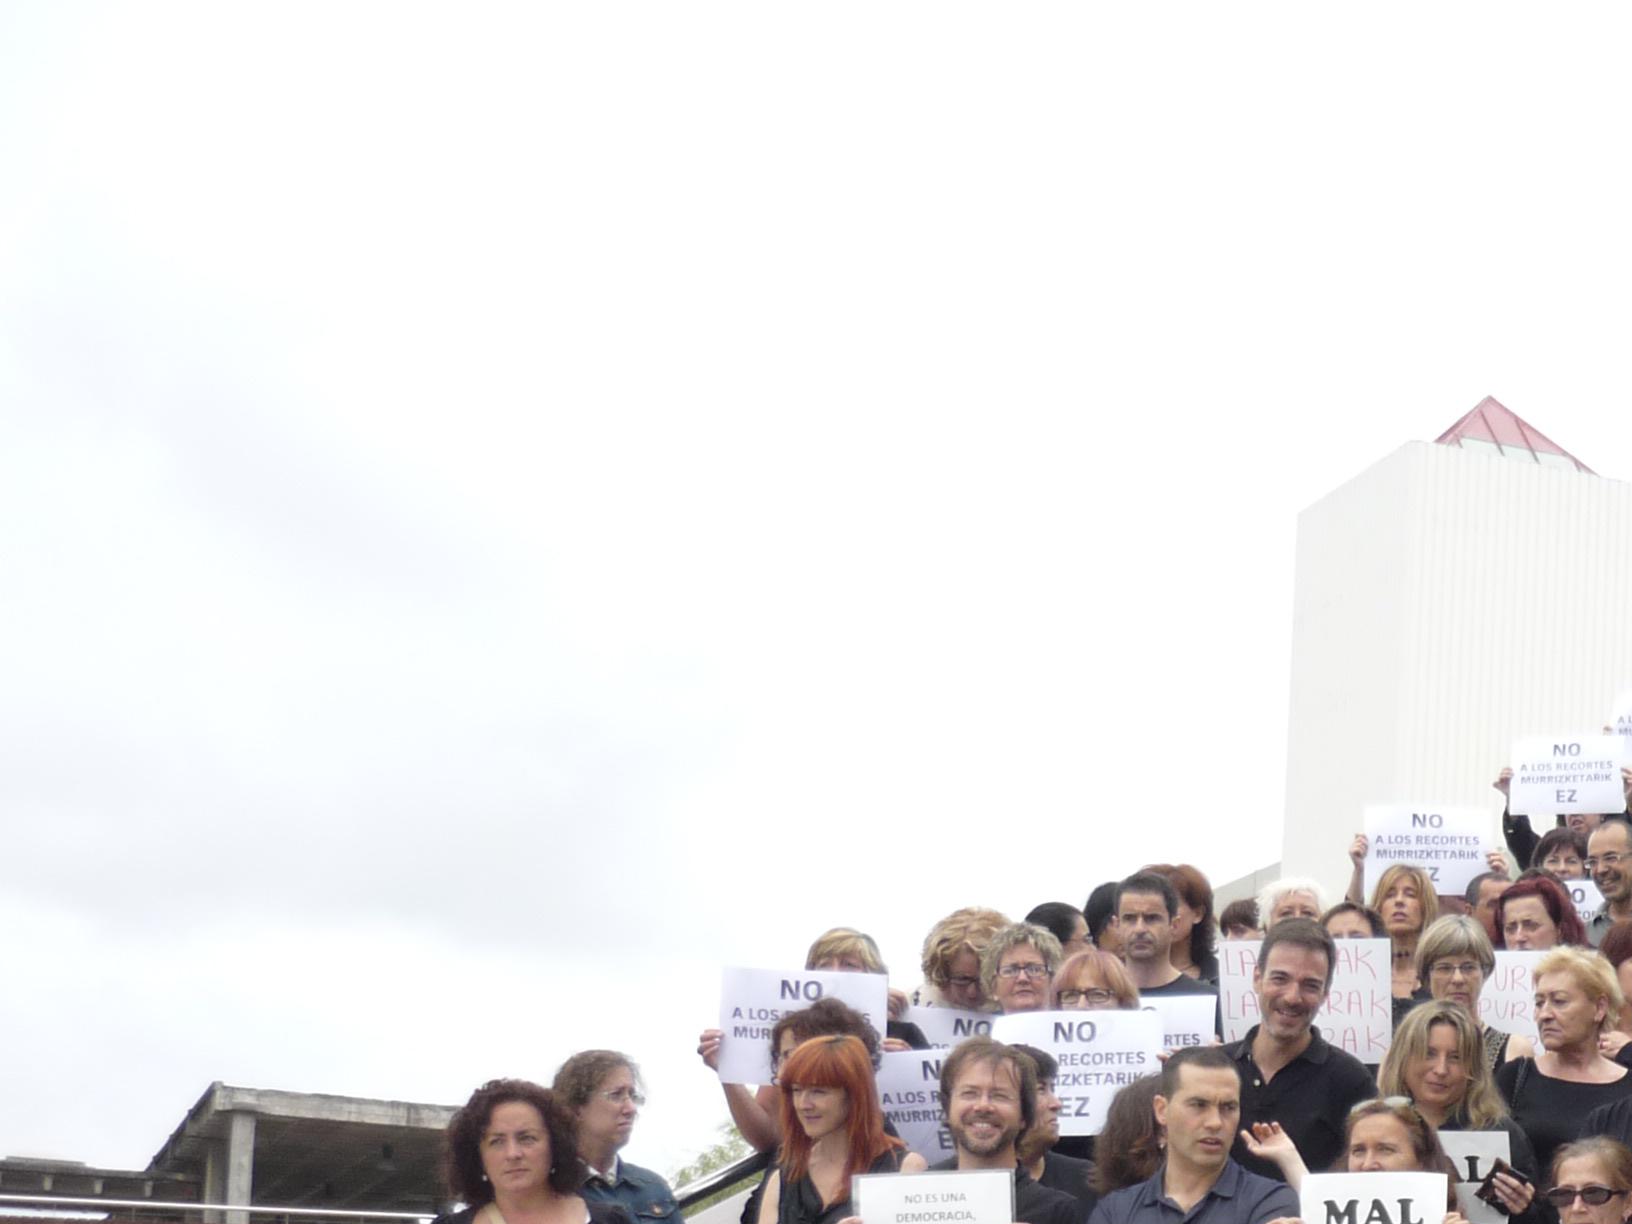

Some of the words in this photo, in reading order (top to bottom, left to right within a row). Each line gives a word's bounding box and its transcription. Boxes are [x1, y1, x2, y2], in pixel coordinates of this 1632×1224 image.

[1618, 715, 1626, 724] A
[1553, 743, 1581, 757] NO
[1520, 763, 1528, 771] A
[1531, 762, 1551, 771] LOS
[1555, 760, 1613, 770] RECORTES
[1520, 774, 1612, 785] MURRIZKETARIK
[1556, 789, 1577, 803] EZ
[1411, 813, 1443, 828] NO
[1375, 835, 1385, 844] A
[1388, 835, 1411, 845] LOS
[1415, 835, 1480, 846] RECORTES
[1376, 849, 1479, 860] MURRIZKETARIK
[781, 979, 824, 1001] NO
[732, 1007, 743, 1019] A
[749, 1008, 779, 1021] LOS
[953, 1018, 991, 1036] NO
[1053, 1021, 1096, 1043] NO
[1058, 1051, 1146, 1067] RECORTES
[883, 1093, 894, 1105] A
[897, 1091, 926, 1104] LOS
[1060, 1096, 1090, 1118] EZ
[904, 1194, 922, 1204] NO
[925, 1193, 939, 1203] ES
[941, 1193, 966, 1203] UNA
[896, 1210, 976, 1223] DEMOCRACIA,
